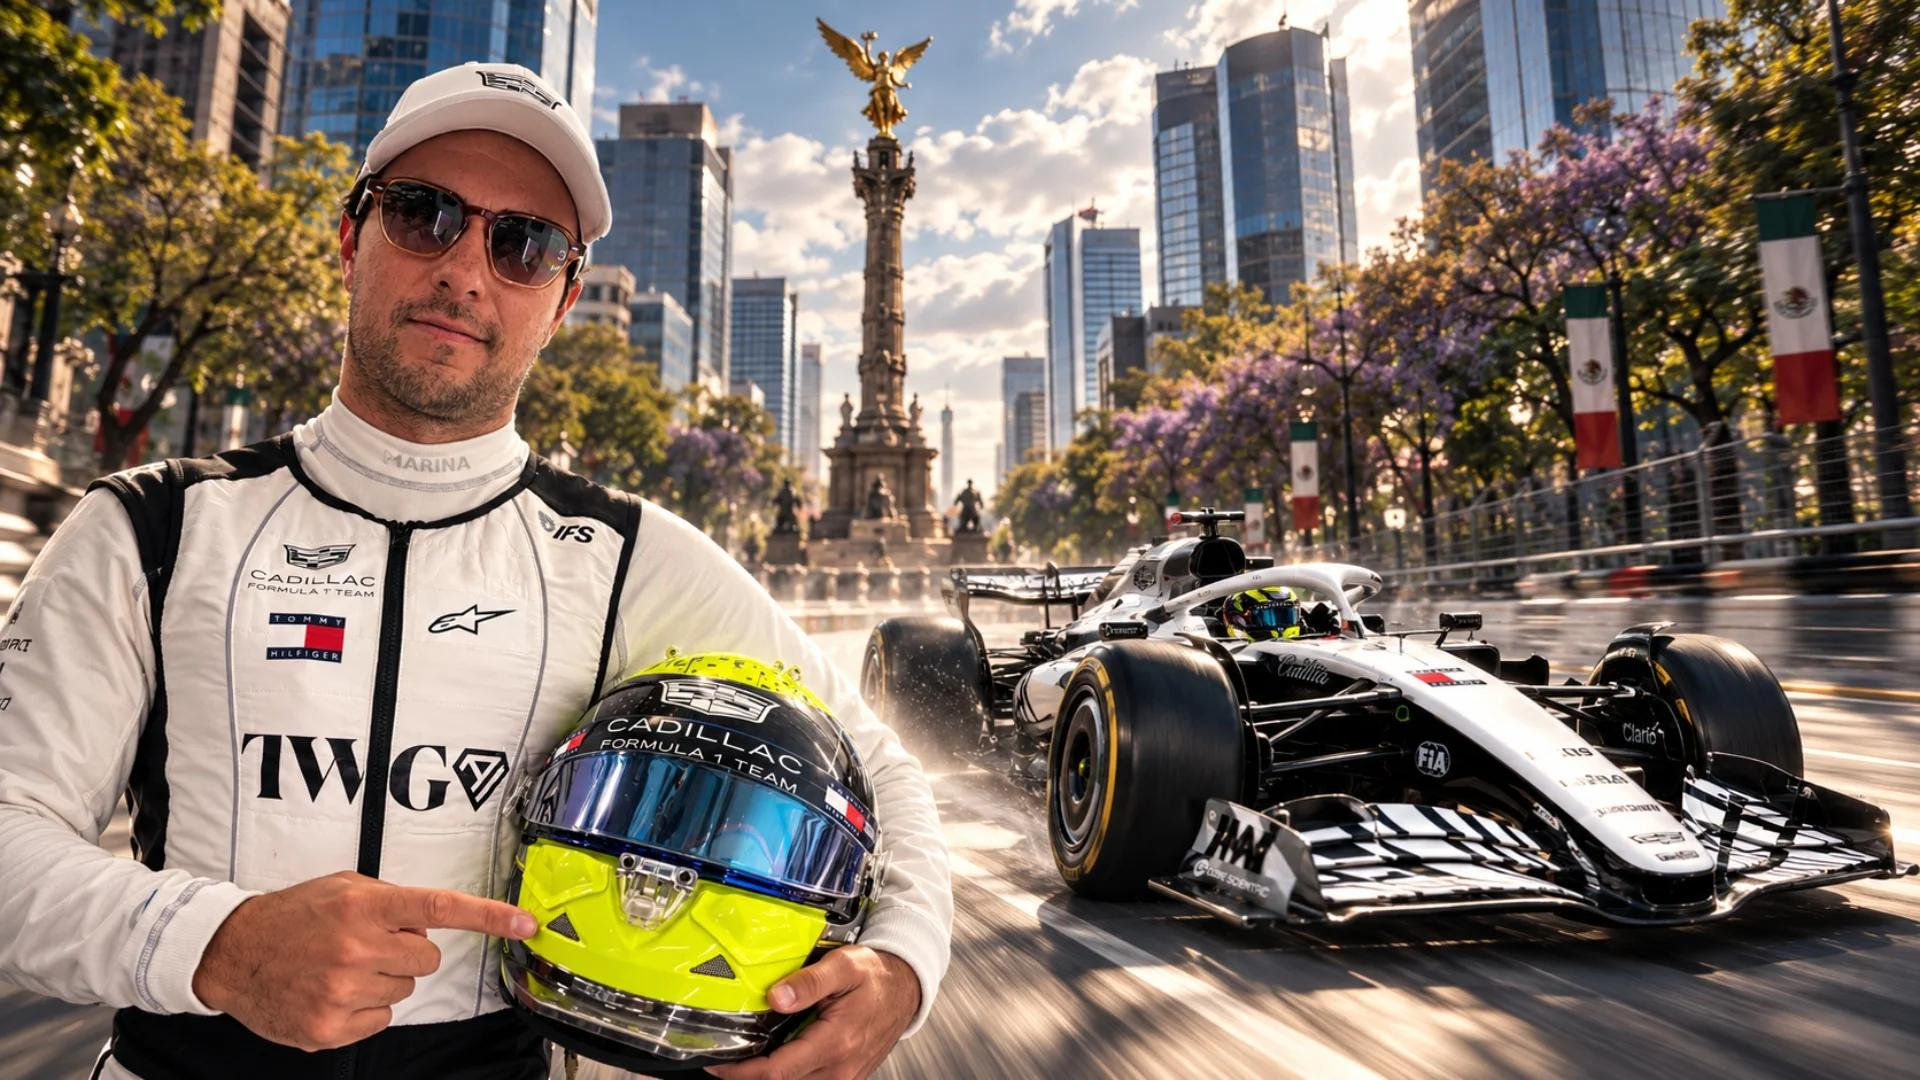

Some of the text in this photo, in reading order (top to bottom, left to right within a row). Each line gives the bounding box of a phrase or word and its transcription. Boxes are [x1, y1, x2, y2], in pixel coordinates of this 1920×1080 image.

[552, 525, 596, 543] IFS
[250, 570, 376, 587] CADILLAC
[247, 582, 319, 595] FORMULA
[335, 589, 375, 598] TEAM
[274, 615, 342, 626] TOMMY
[270, 650, 339, 661] HILFIGER
[607, 717, 803, 775] CADILLAC
[600, 738, 799, 795] FORMULA 1 TEAM
[1418, 746, 1447, 774] FIA
[241, 733, 451, 812] TWG
